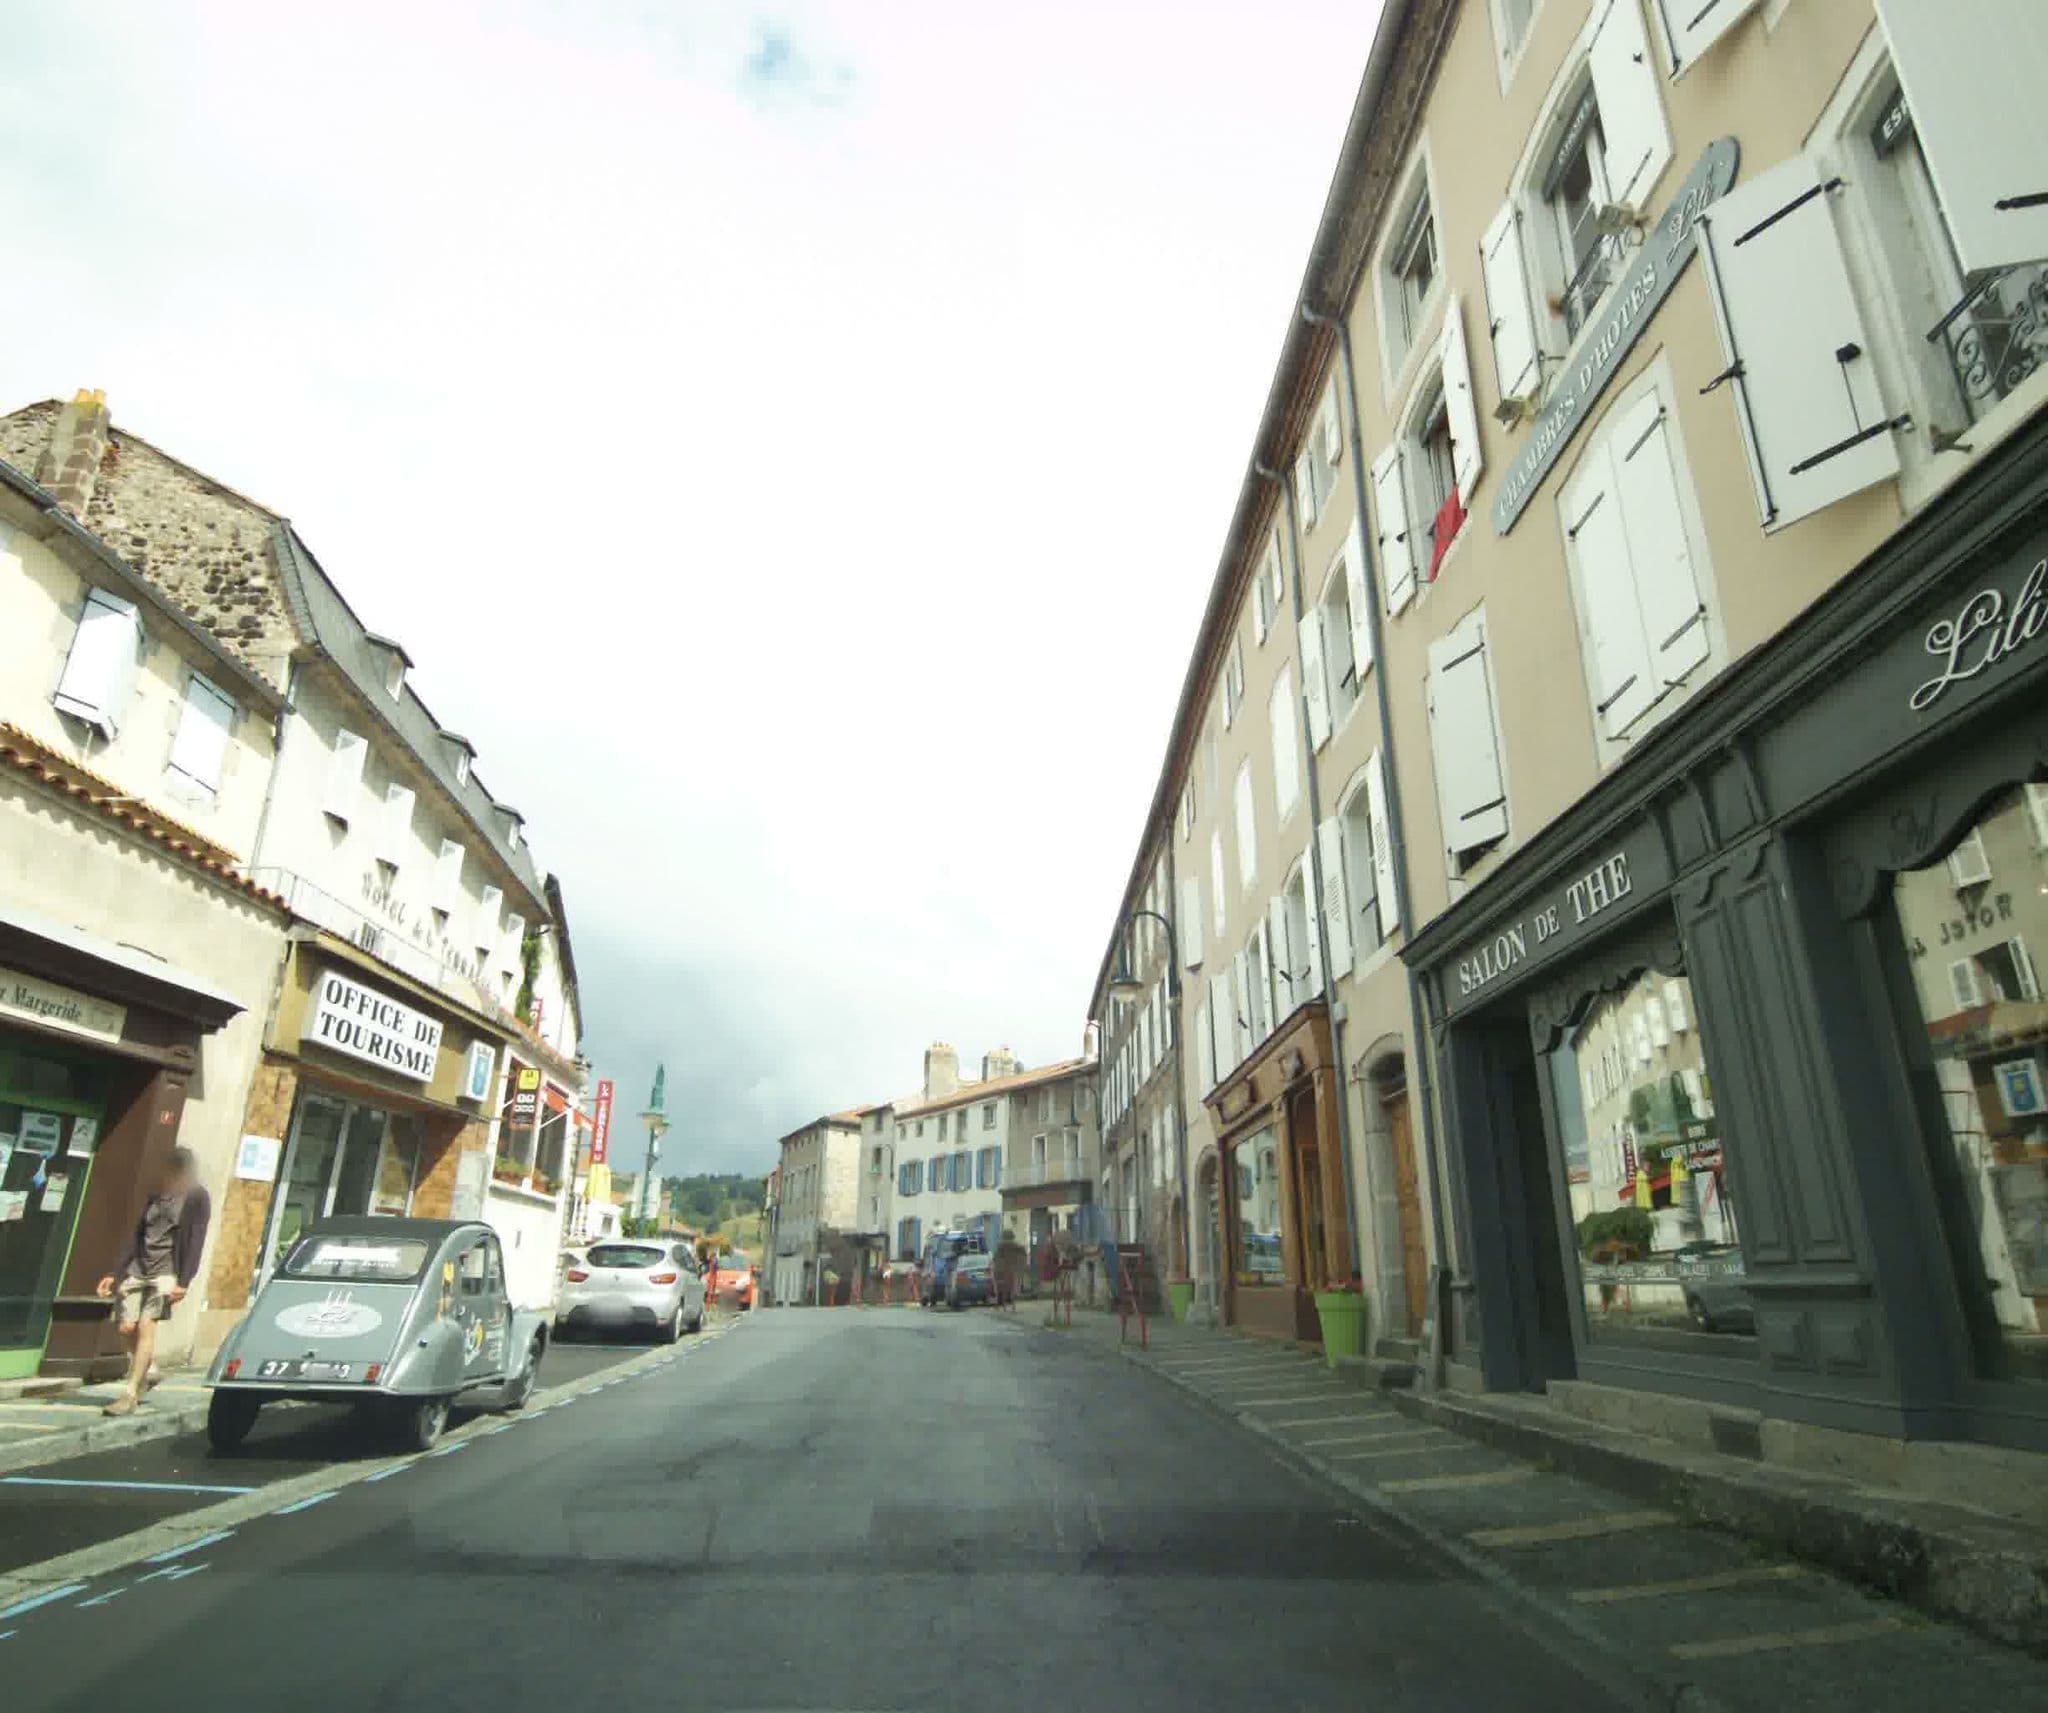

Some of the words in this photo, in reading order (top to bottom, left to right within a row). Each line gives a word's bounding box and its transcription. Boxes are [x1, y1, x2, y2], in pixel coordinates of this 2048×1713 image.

[1459, 922, 1527, 995] SALON
[1534, 904, 1561, 944] DE
[1566, 851, 1633, 924] THE
[321, 1010, 435, 1077] TOURISME
[326, 979, 407, 1033] OFFICE
[414, 1020, 439, 1049] DE
